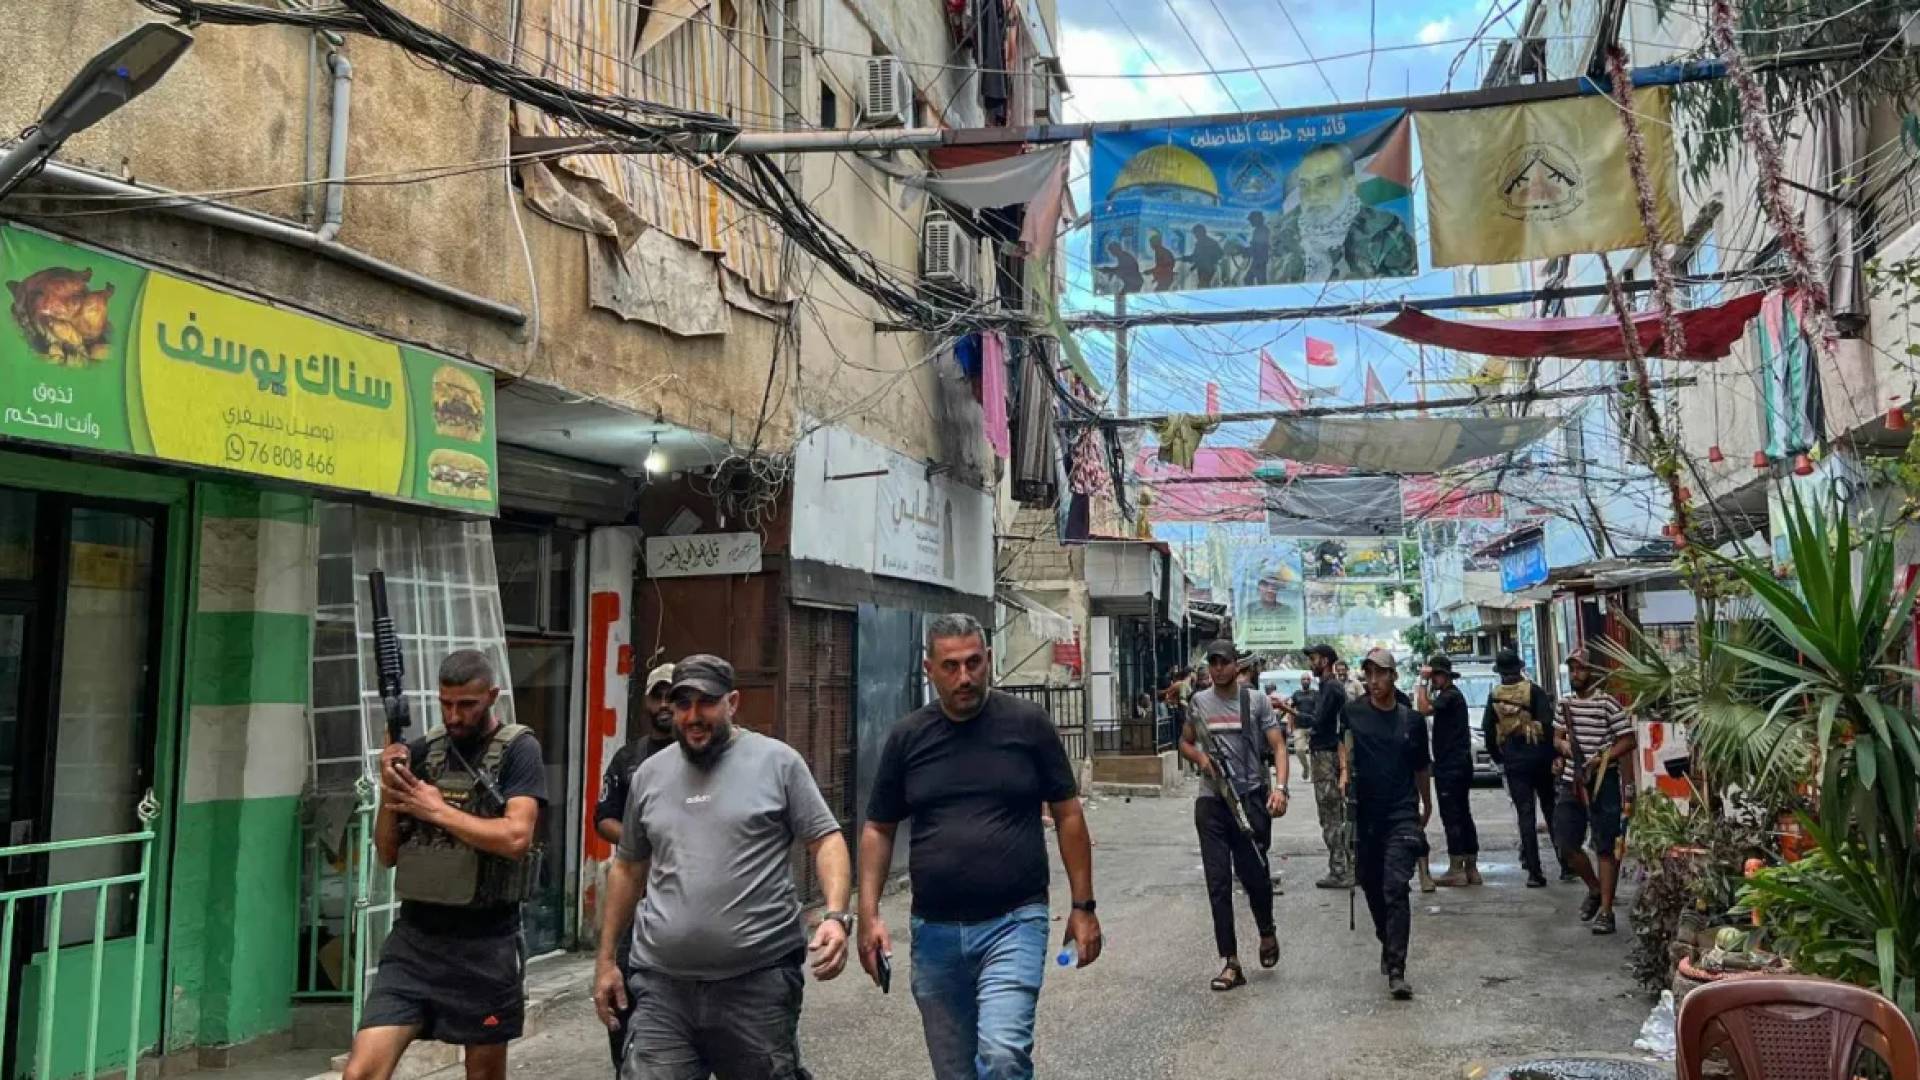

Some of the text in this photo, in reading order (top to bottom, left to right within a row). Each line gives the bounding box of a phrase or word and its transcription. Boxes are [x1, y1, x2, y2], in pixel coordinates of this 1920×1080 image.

[1190, 123, 1251, 148] المناضلين
[1321, 113, 1346, 136] قائد
[157, 312, 392, 410] سناك يوسف
[32, 383, 73, 404] تذوق
[4, 407, 100, 440] وأنت الحكم
[286, 416, 334, 442] توصيل
[248, 440, 335, 476] 76 808 466
